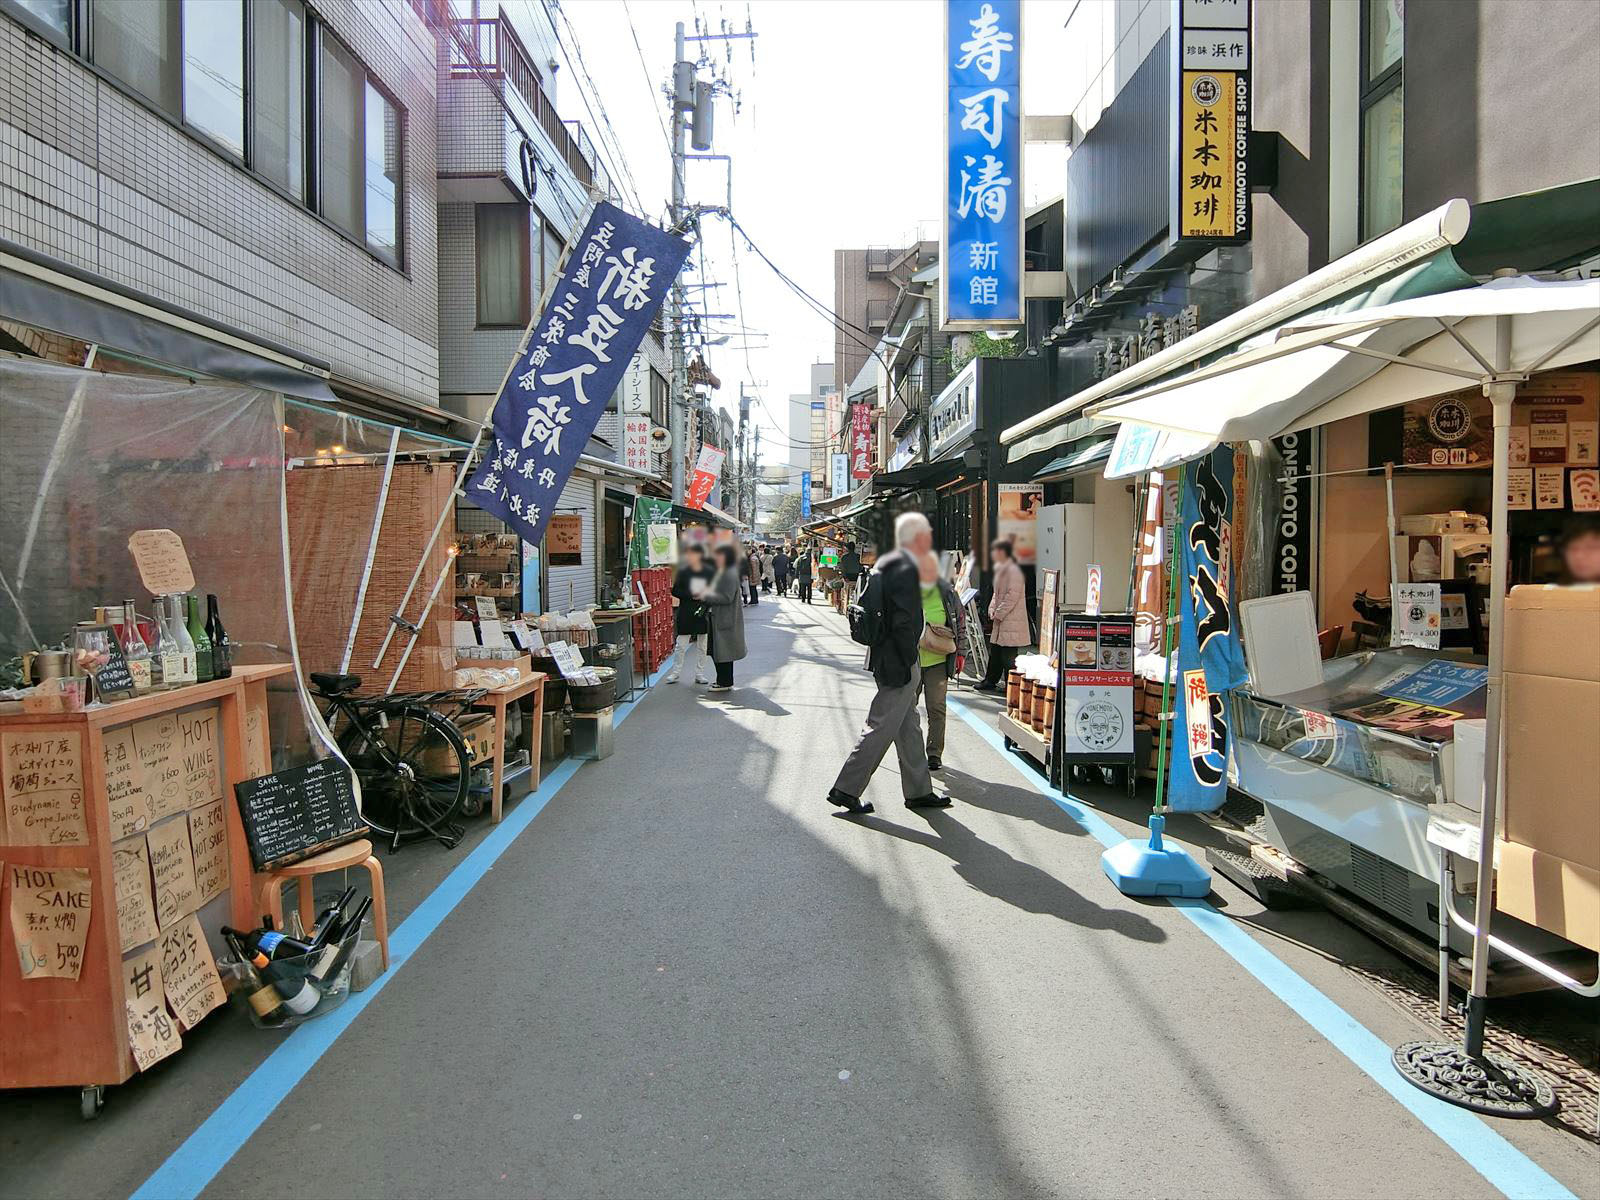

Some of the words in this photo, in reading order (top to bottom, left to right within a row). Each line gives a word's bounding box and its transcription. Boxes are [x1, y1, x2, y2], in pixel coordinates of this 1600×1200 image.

[1187, 46, 1207, 55] 珍味
[1212, 43, 1244, 57] 浜作
[1236, 77, 1247, 113] SHOP
[955, 3, 1013, 223] 寿司清
[1236, 114, 1246, 159] COFFEE
[1190, 108, 1222, 226] 米本珈琲
[1236, 161, 1246, 234] YONEMOTO
[969, 240, 998, 305] 新館
[632, 355, 642, 411] フォーシーズン
[627, 422, 637, 469] 輸入雑貨
[638, 422, 648, 469] 韓国食材
[854, 431, 871, 473] 寿屋
[1065, 674, 1132, 683] 当店セルフサービスです
[10, 738, 72, 757] オーストリア産
[182, 716, 213, 748] HOT
[139, 741, 172, 760] オレンジワイン
[183, 747, 213, 773] WINE
[258, 775, 279, 789] SAKE
[307, 763, 325, 774] WINE
[112, 805, 134, 821] 500円
[194, 839, 207, 858] HOT
[209, 830, 225, 850] SAKE
[14, 868, 56, 888] HOT
[36, 889, 90, 909] SAKE
[57, 942, 79, 970] 500
[161, 924, 193, 963] スパイス
[171, 939, 198, 972] ココア
[130, 962, 172, 1042] 甘酒
